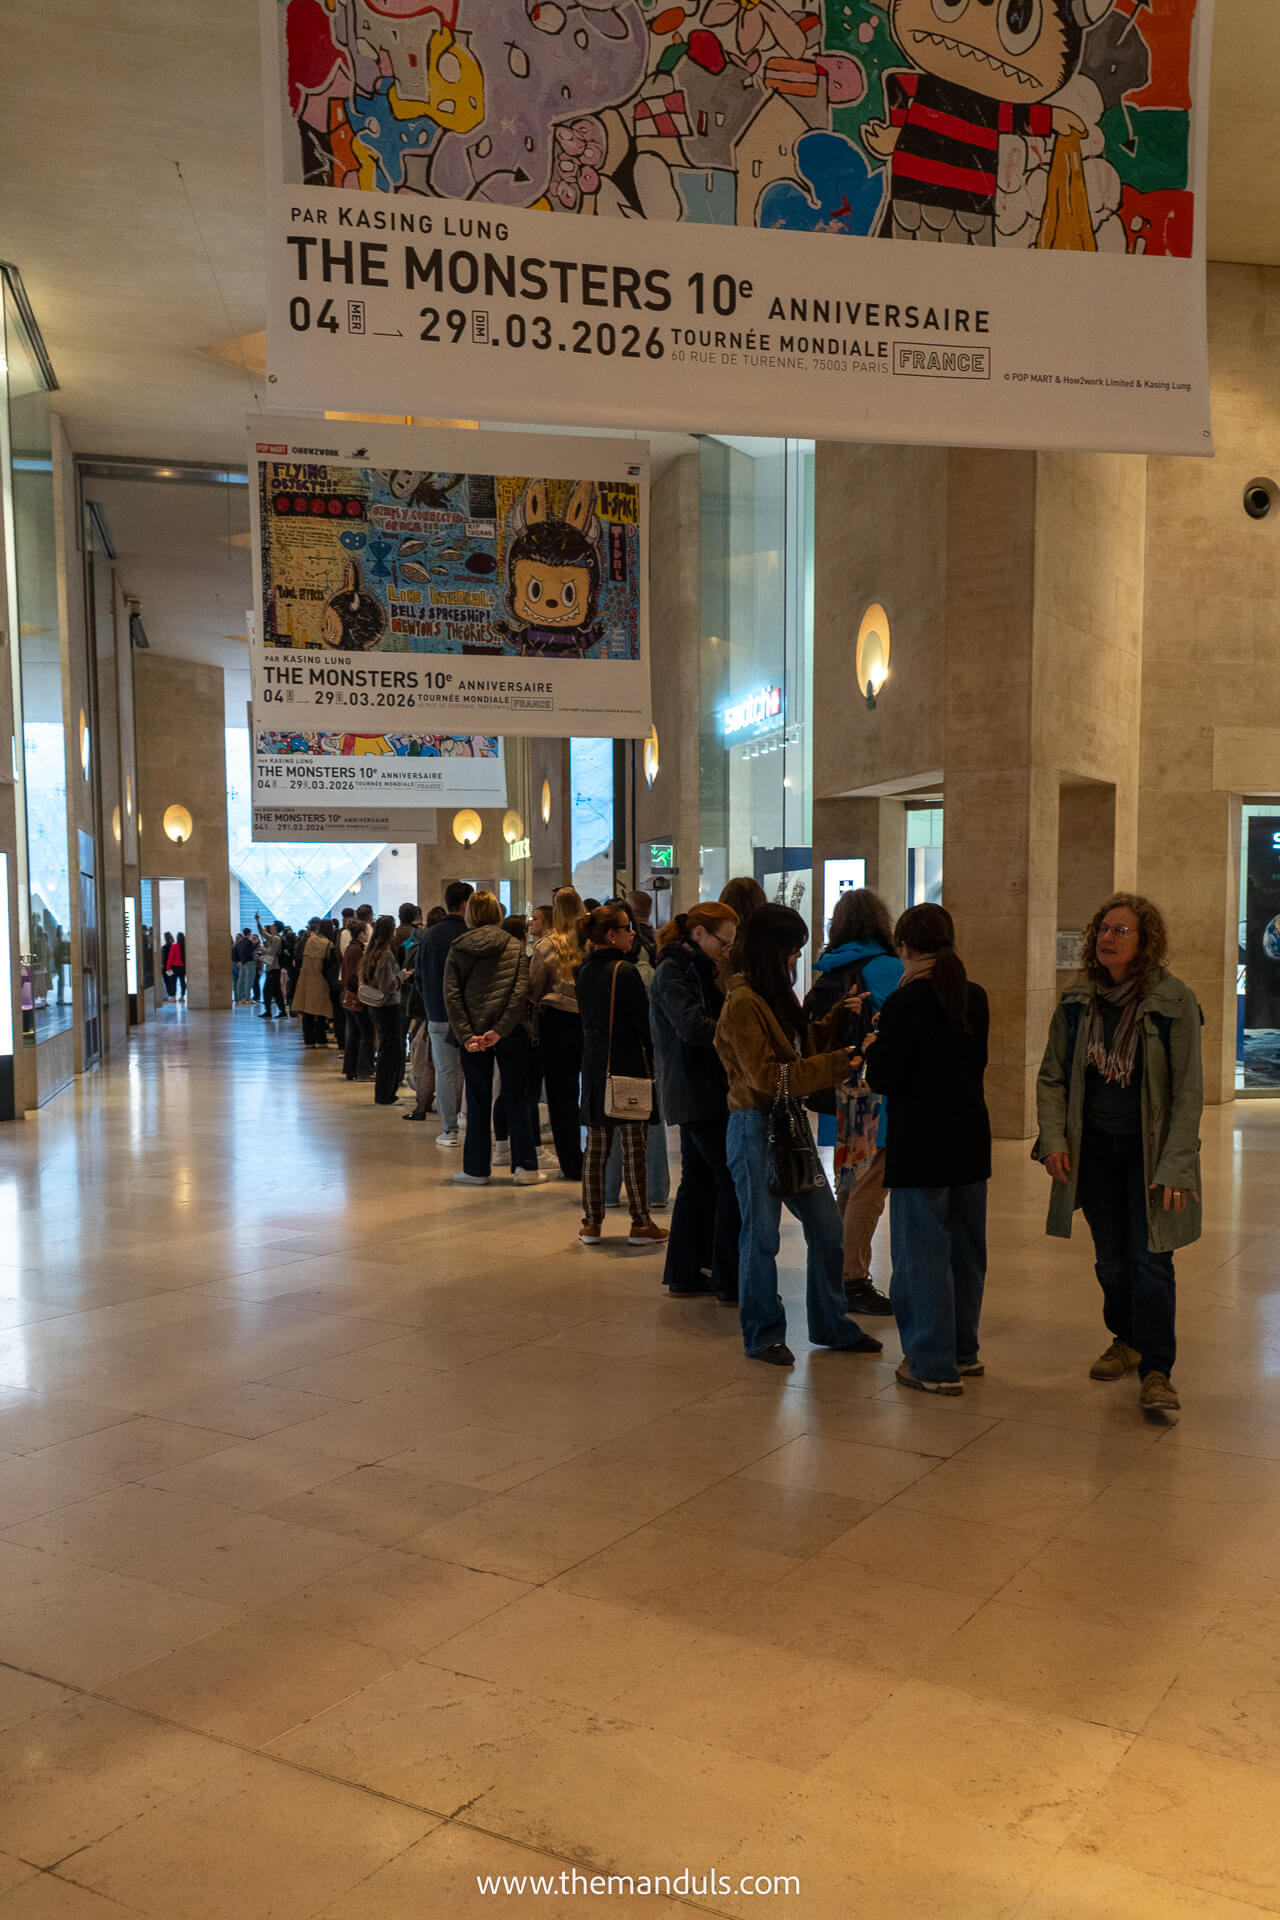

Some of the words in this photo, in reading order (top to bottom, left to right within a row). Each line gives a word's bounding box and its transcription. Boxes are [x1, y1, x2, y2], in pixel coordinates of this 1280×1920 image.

[292, 208, 327, 224] PAR
[339, 207, 432, 233] KASING
[445, 217, 508, 241] LUNG
[287, 236, 388, 287] THE
[405, 246, 671, 311] MONSTERS
[768, 297, 989, 332] ANNIVERSAIRE
[290, 297, 339, 333] 04
[350, 304, 362, 331] MER
[475, 314, 487, 338] DIM
[671, 329, 770, 350] TOURNÉE
[781, 336, 888, 357] MONDIALE
[899, 350, 984, 372] FRANCE
[672, 351, 684, 361] 60
[691, 351, 716, 363] RUE
[721, 353, 737, 365] DE
[743, 355, 807, 370] TURENNE,
[813, 359, 847, 371] 75003
[853, 361, 888, 373] PARIS
[1012, 373, 1029, 382] POP
[1031, 375, 1054, 384] MART
[1063, 377, 1104, 386] How2work
[1105, 379, 1135, 388] Limited
[1144, 380, 1171, 391] Kasing
[283, 655, 320, 664] KASING
[325, 657, 351, 665] LUNG
[264, 667, 303, 684] THE
[310, 669, 418, 688] MONSTERS
[459, 681, 552, 692] ANNIVERSAIRE
[264, 689, 283, 702] 04
[418, 694, 460, 702] TOURNÉE
[514, 700, 551, 708] FRANCE
[257, 766, 283, 776] THE
[287, 766, 355, 777] MONSTERS
[258, 780, 270, 788] 04
[255, 813, 272, 822] THE
[275, 813, 325, 823] MONSTERS
